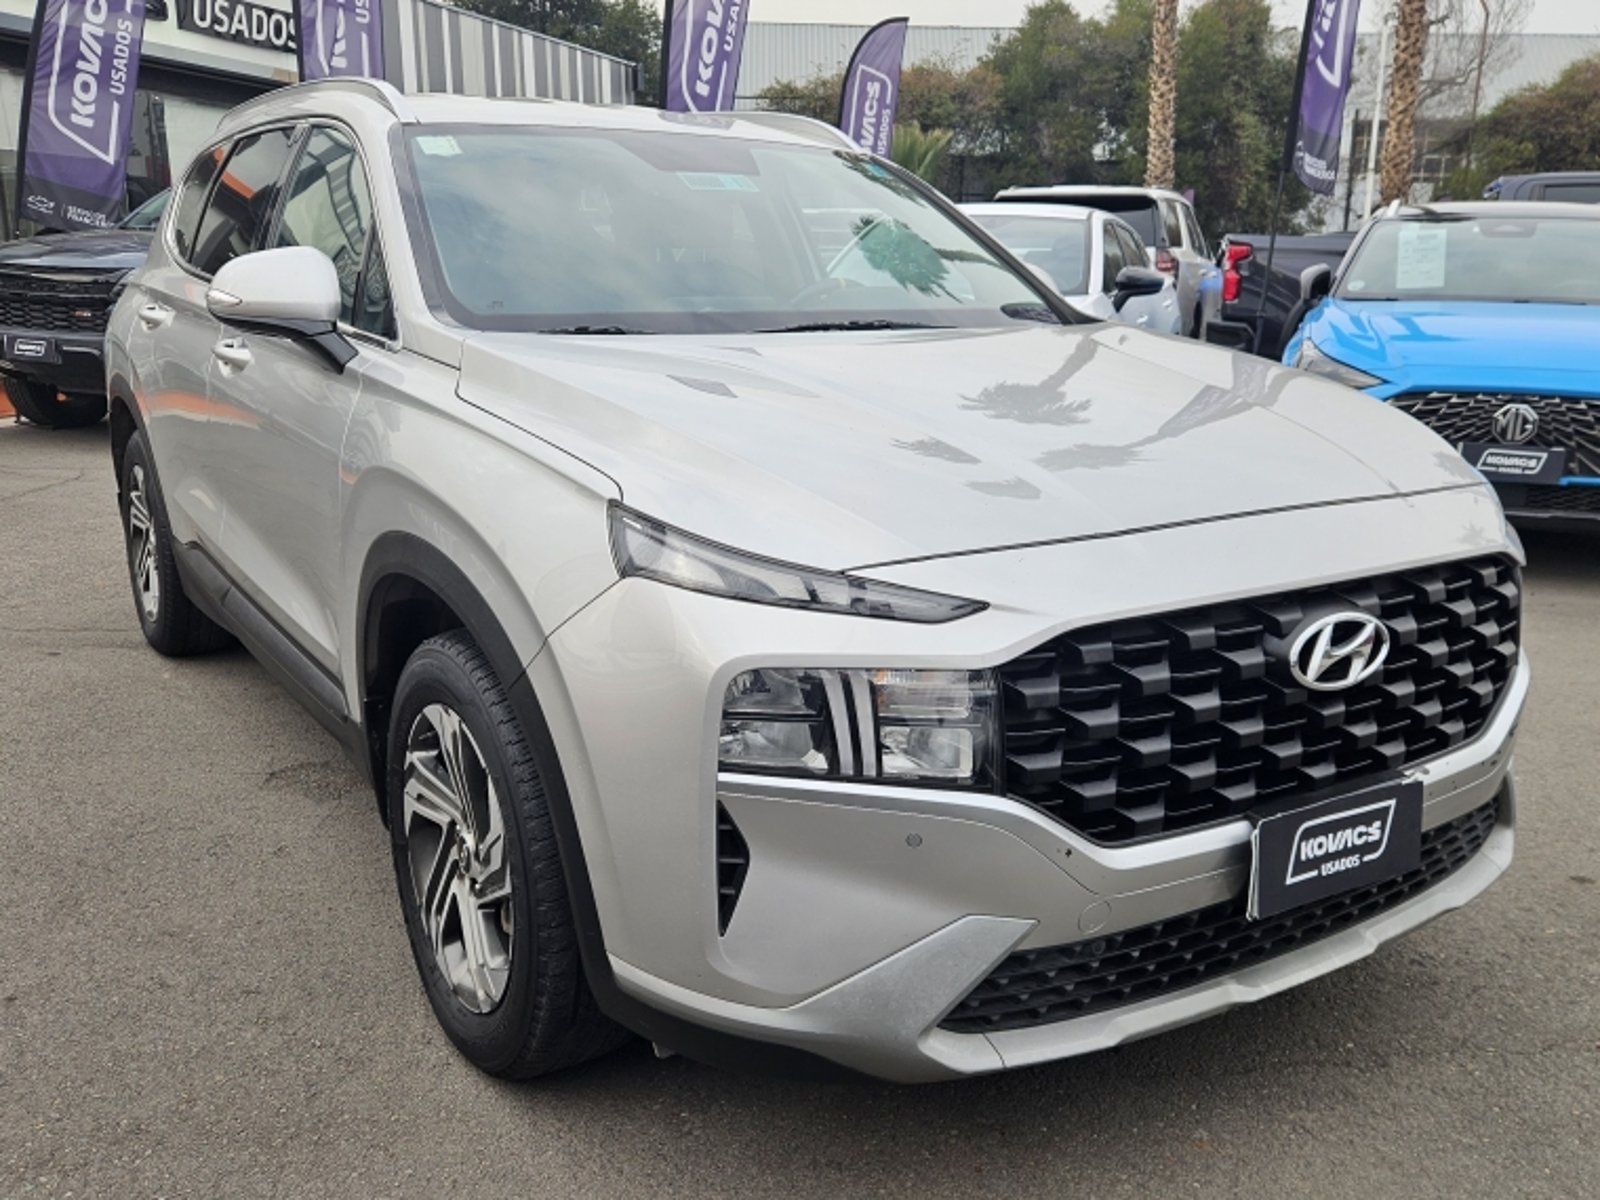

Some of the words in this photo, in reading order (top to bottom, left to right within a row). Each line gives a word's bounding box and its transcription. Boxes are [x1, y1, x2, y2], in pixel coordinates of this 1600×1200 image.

[109, 18, 133, 96] USADOS
[1300, 820, 1382, 861] KOVACS
[1321, 854, 1361, 877] USADOS
